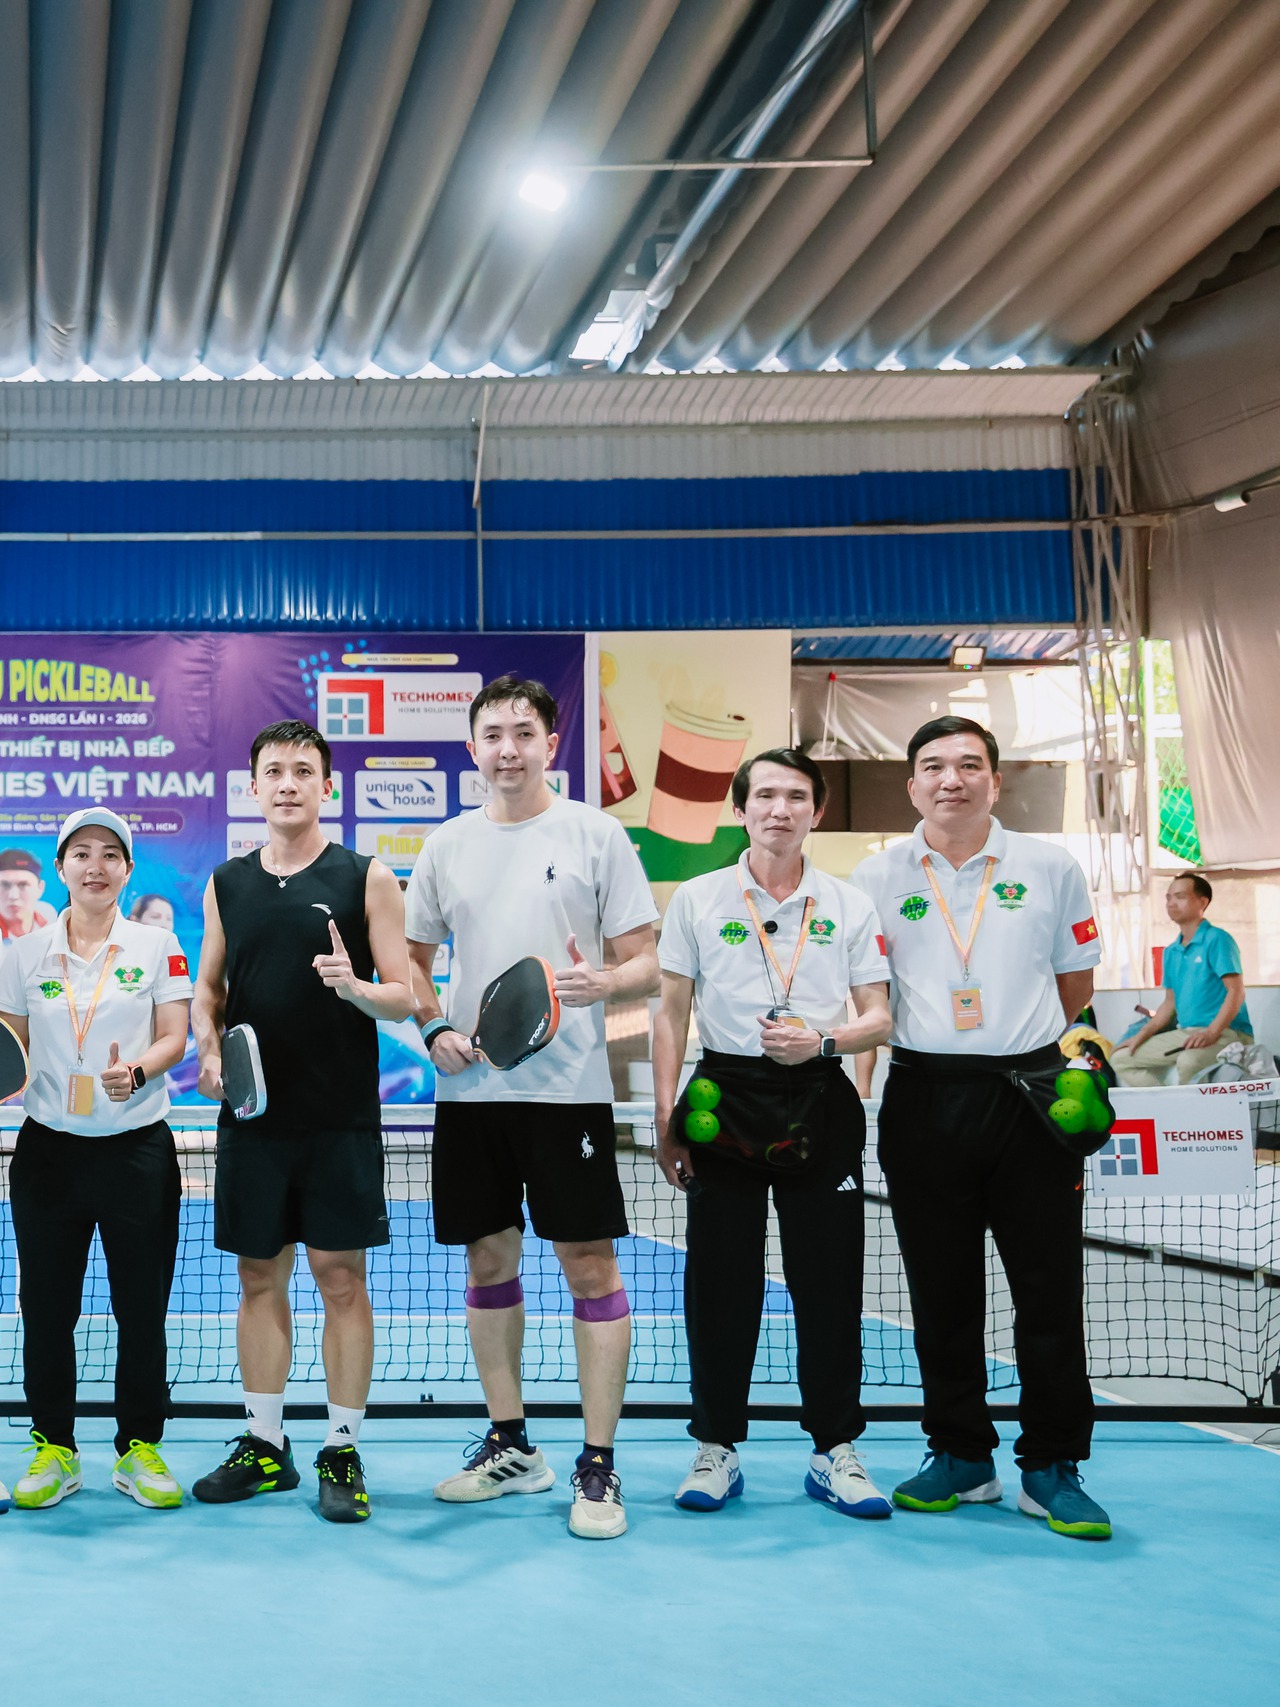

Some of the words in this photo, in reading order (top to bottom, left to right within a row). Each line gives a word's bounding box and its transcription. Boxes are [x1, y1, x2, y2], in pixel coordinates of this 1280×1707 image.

[9, 658, 156, 702] PICKLEBALL
[391, 691, 473, 703] TECHHOMES
[29, 713, 67, 726] DNSG
[115, 713, 148, 725] 2026
[58, 740, 80, 761] BỊ
[84, 736, 130, 758] NHÀ
[133, 735, 175, 758] BẾP
[53, 765, 129, 804] VIỆT
[137, 771, 215, 798] NAM
[366, 780, 414, 796] unique
[393, 793, 436, 806] house
[377, 833, 423, 855] Pima
[528, 1018, 545, 1045] JOOLA
[1199, 1082, 1272, 1095] VIFASPORT
[1163, 1130, 1244, 1142] TECHHOMES
[1196, 1145, 1238, 1153] SOLUTIONS
